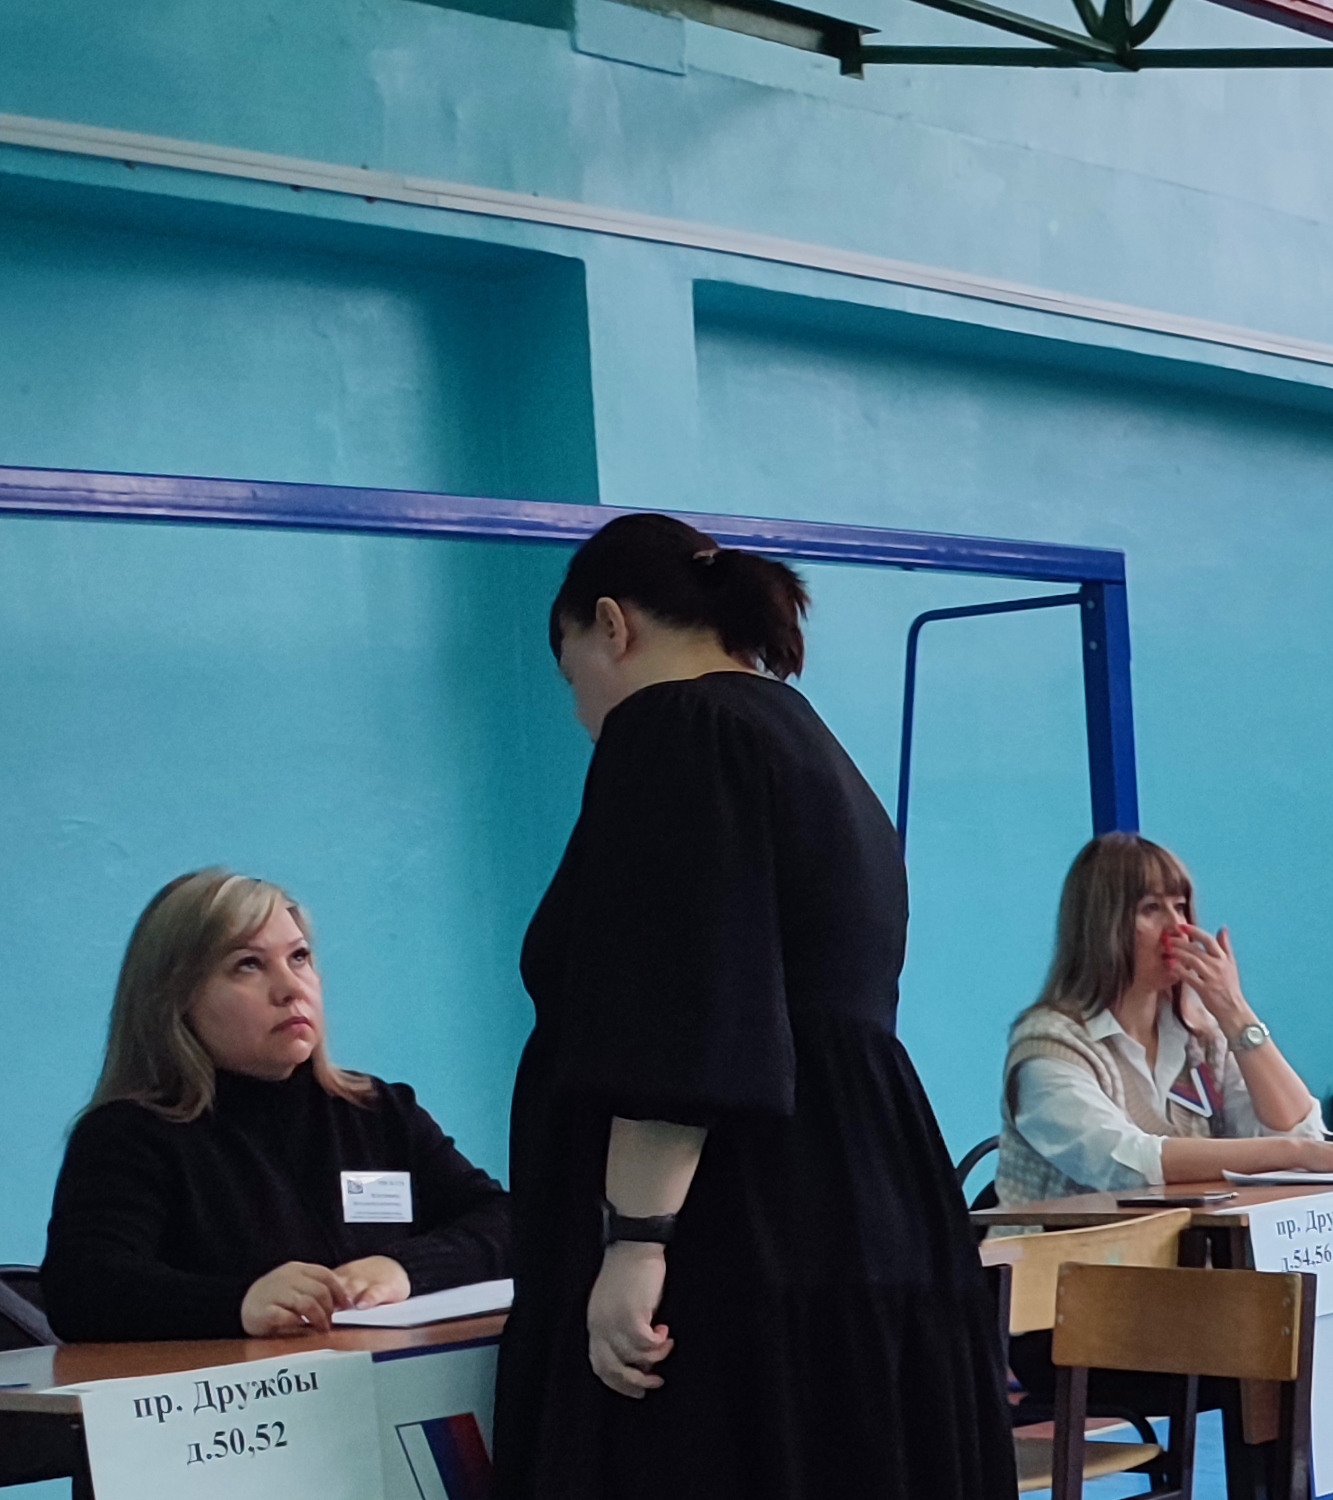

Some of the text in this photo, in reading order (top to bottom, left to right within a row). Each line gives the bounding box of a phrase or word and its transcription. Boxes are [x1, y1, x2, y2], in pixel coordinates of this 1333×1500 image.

[1276, 1219, 1301, 1239] пр.
[133, 1368, 320, 1424] пр. Дружбы
[186, 1420, 288, 1466] д.50,52
